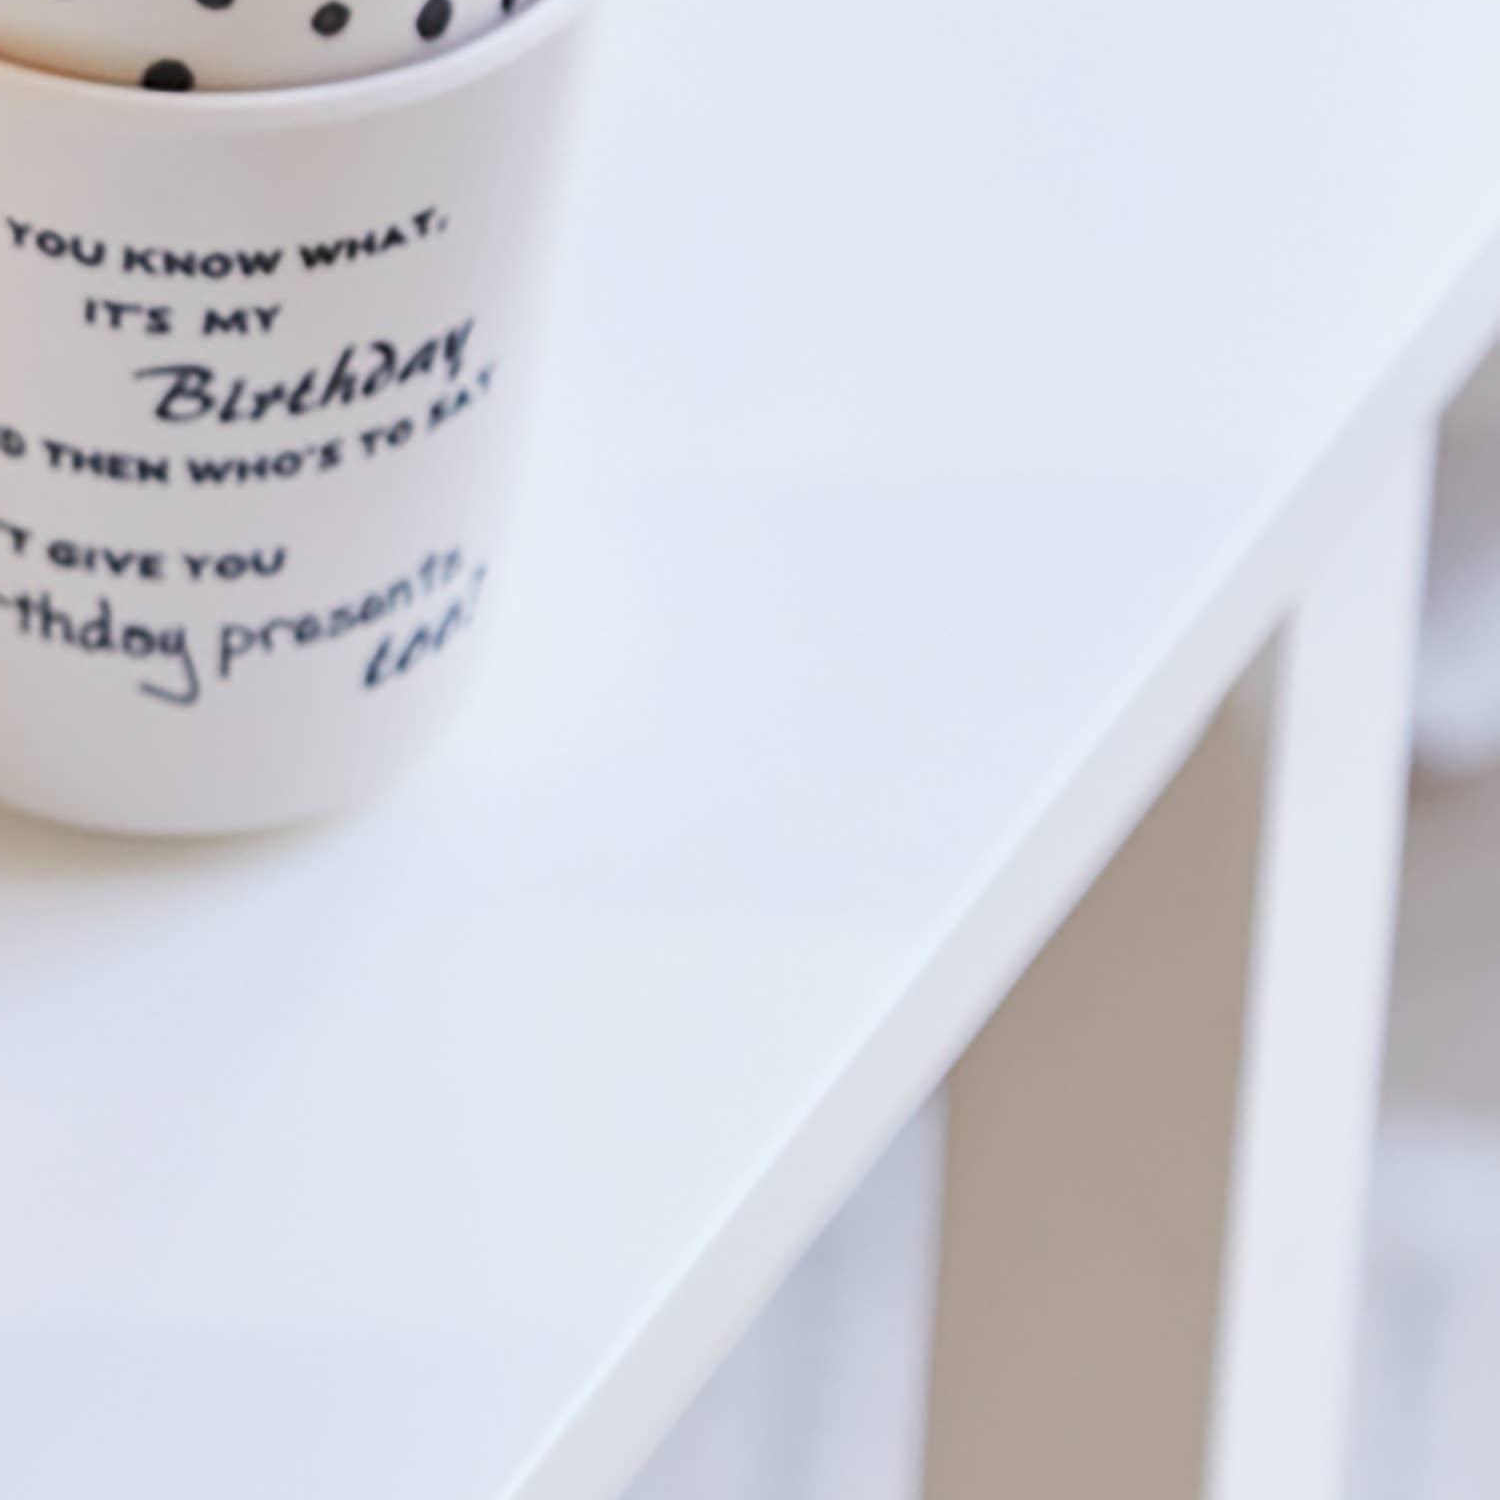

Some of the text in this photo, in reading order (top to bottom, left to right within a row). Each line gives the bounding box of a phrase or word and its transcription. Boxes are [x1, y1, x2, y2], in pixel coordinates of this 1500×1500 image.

[6, 216, 106, 268] YOU
[122, 244, 284, 280] KNOW
[83, 297, 283, 336] IT'S MY
[132, 314, 476, 424] Birthday
[42, 438, 170, 485] THEN
[186, 438, 346, 486] WHO'S
[360, 418, 414, 458] TO
[46, 540, 166, 580] GIVE
[182, 546, 288, 580] YOU
